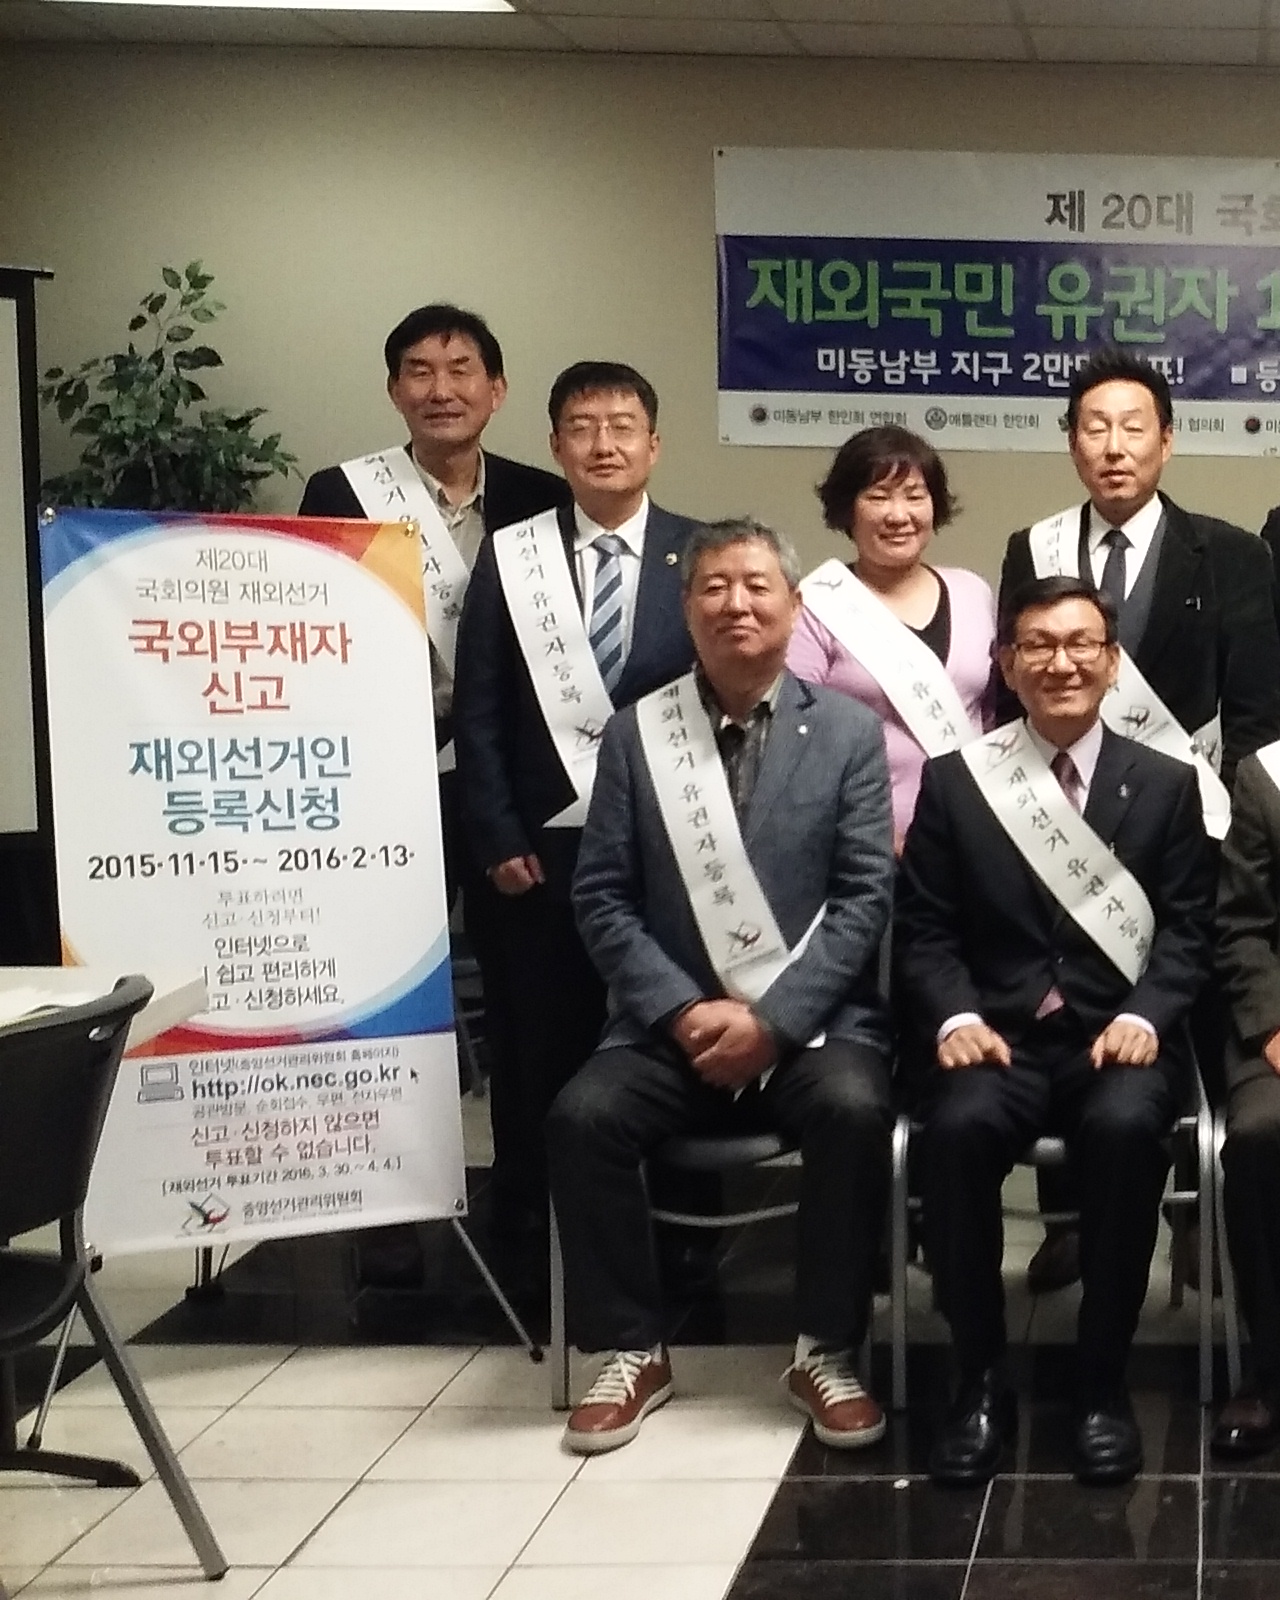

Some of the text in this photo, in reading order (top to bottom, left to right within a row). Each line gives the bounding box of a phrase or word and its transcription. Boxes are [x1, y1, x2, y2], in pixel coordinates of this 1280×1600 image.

[1045, 189, 1086, 233] 제
[1100, 191, 1194, 234] 20대
[745, 258, 1015, 339] 재외국민
[1035, 262, 1239, 343] 유권자
[817, 347, 942, 385] 미동남부
[951, 350, 1013, 386] 지구
[773, 409, 822, 424] 미동남부
[1003, 413, 1039, 430] 한인회
[195, 547, 270, 573] 제20대
[134, 578, 330, 607] 국회의원 재외선거
[127, 617, 354, 666] 국외부재자
[201, 670, 291, 716] 신고
[127, 734, 354, 784] 재외선거인
[161, 786, 343, 837] 등록신청
[1009, 765, 1071, 853] 재외선거
[679, 782, 736, 907] 유권자등록
[214, 933, 310, 960] 인터넷으로
[216, 963, 254, 987] 쉽고
[262, 957, 336, 984] 편리하게
[191, 1062, 400, 1101] http://ok.nec.go.kr
[323, 1109, 380, 1133] 않으면
[205, 1133, 376, 1170] 투표할 수 없습니다.
